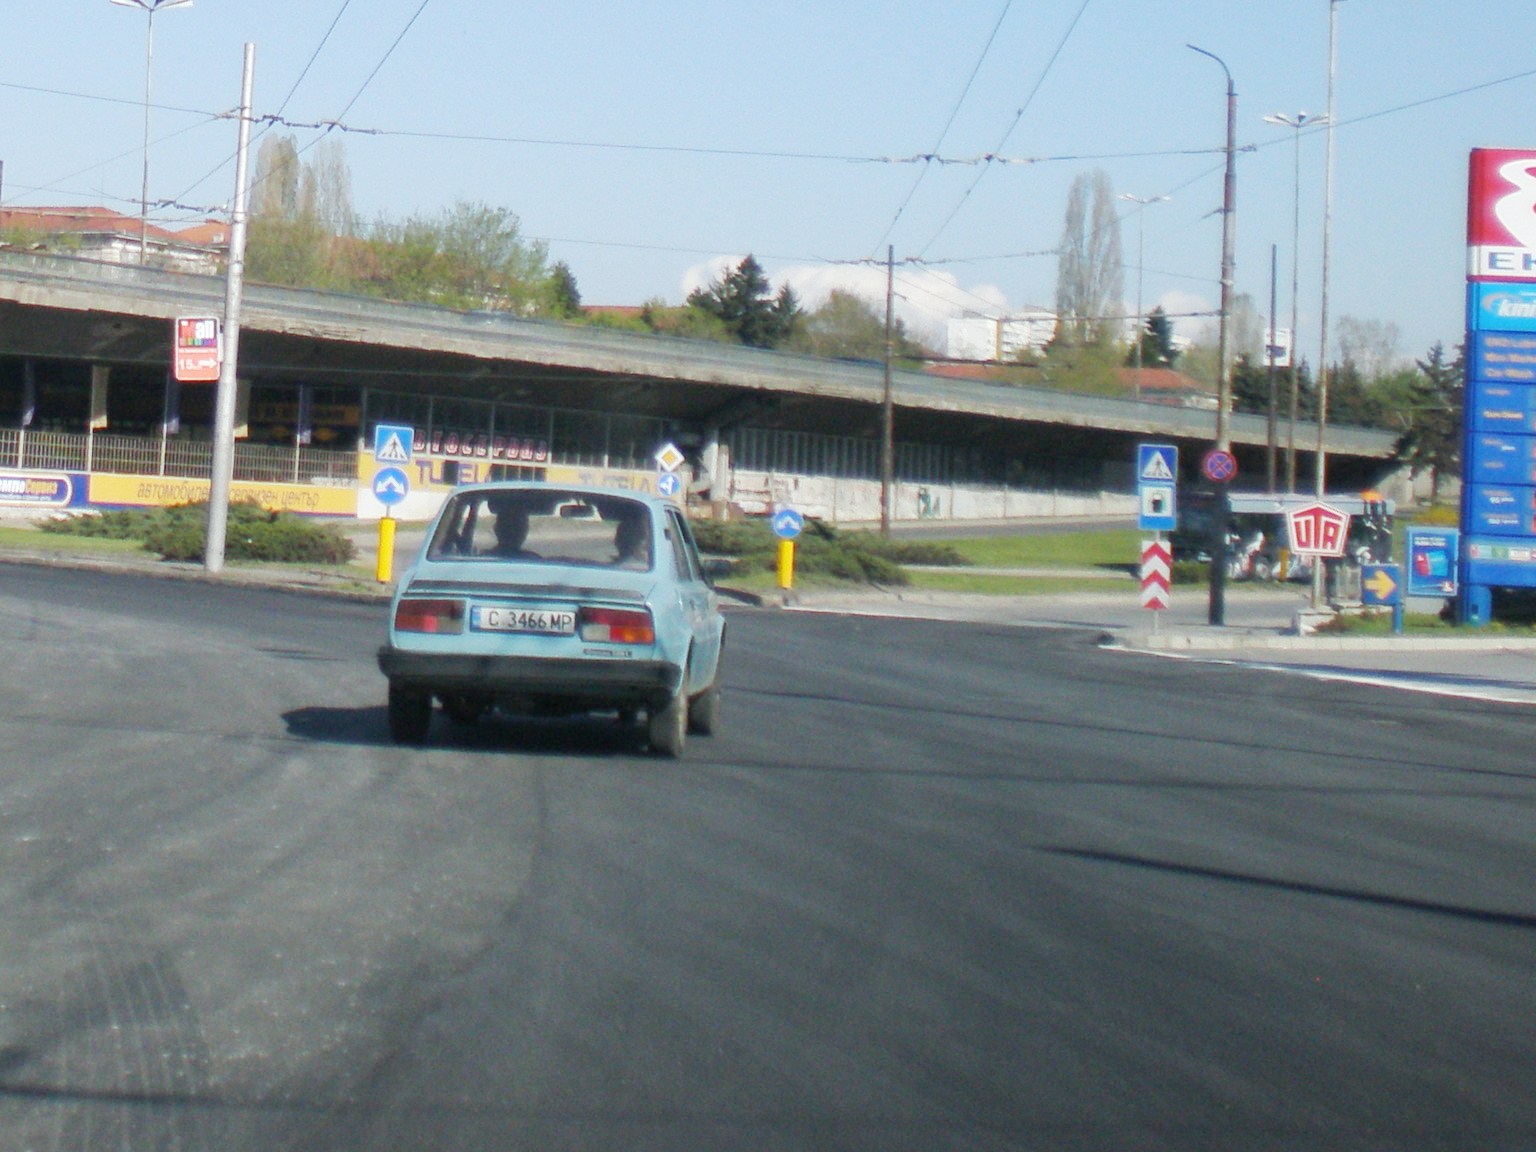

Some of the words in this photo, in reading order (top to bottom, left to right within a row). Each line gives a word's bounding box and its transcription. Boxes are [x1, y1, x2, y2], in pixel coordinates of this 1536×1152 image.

[137, 482, 211, 501] автомобиле
[507, 612, 547, 629] 3466
[550, 613, 573, 630] MP
